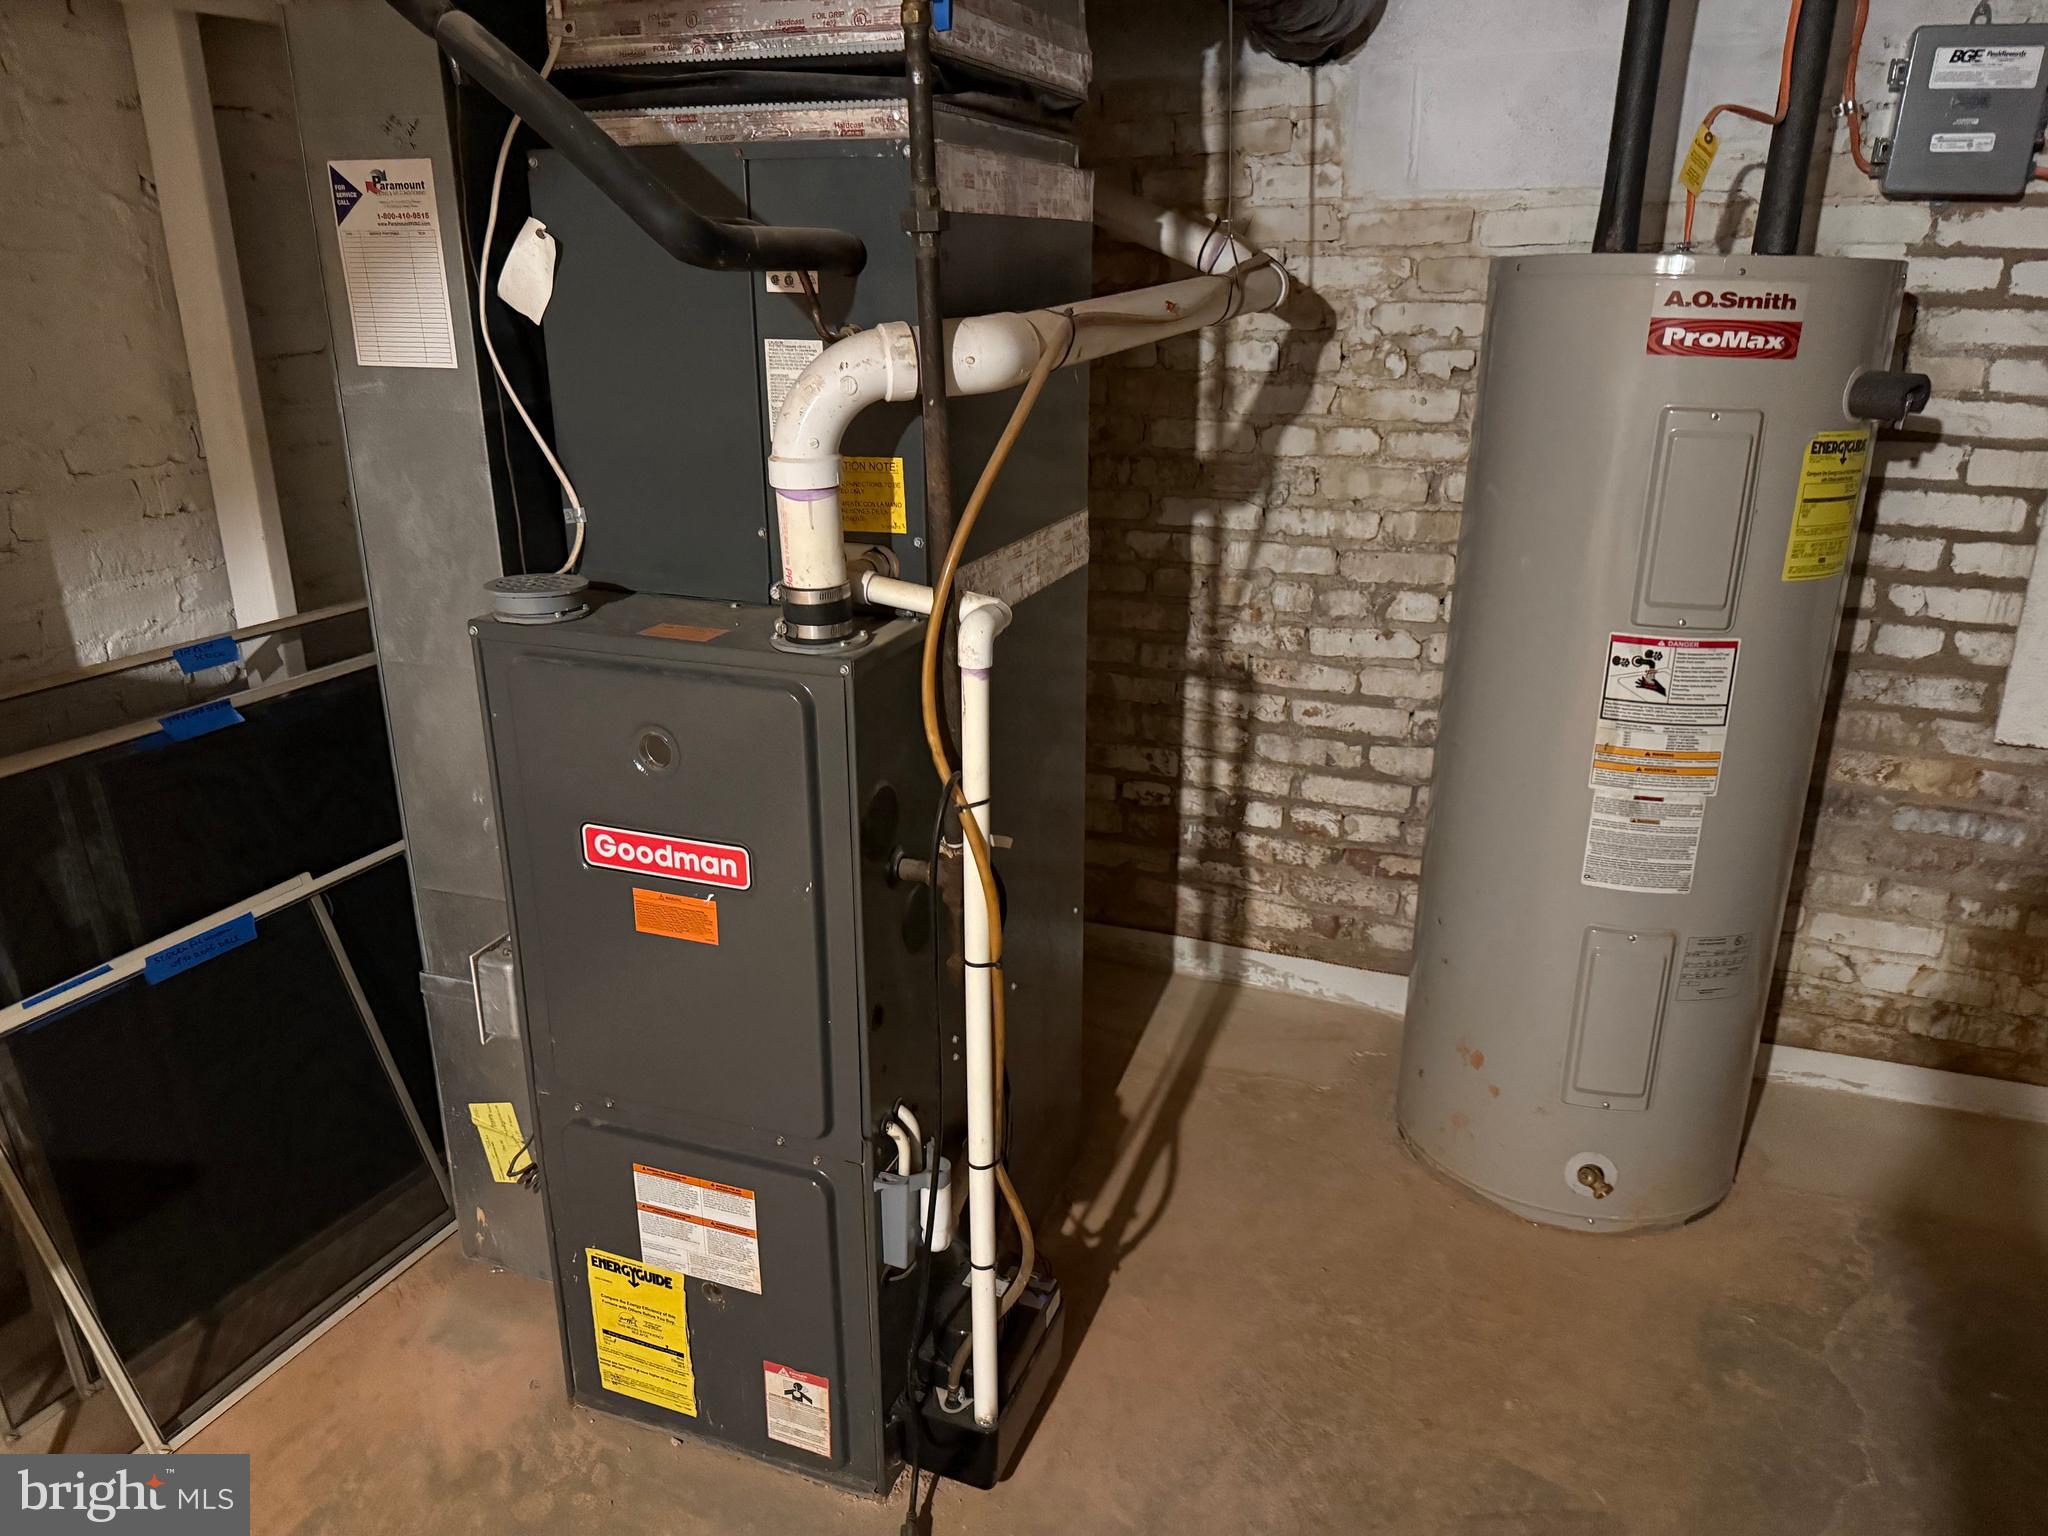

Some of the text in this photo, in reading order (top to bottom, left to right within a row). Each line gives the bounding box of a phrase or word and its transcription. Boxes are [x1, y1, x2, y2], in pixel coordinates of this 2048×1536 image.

[1949, 48, 1985, 63] BGE
[371, 176, 425, 191] Paramount
[1662, 326, 1785, 350] ProMax
[594, 834, 738, 878] Goodman
[591, 1255, 673, 1290] ENERGYGUIDE
